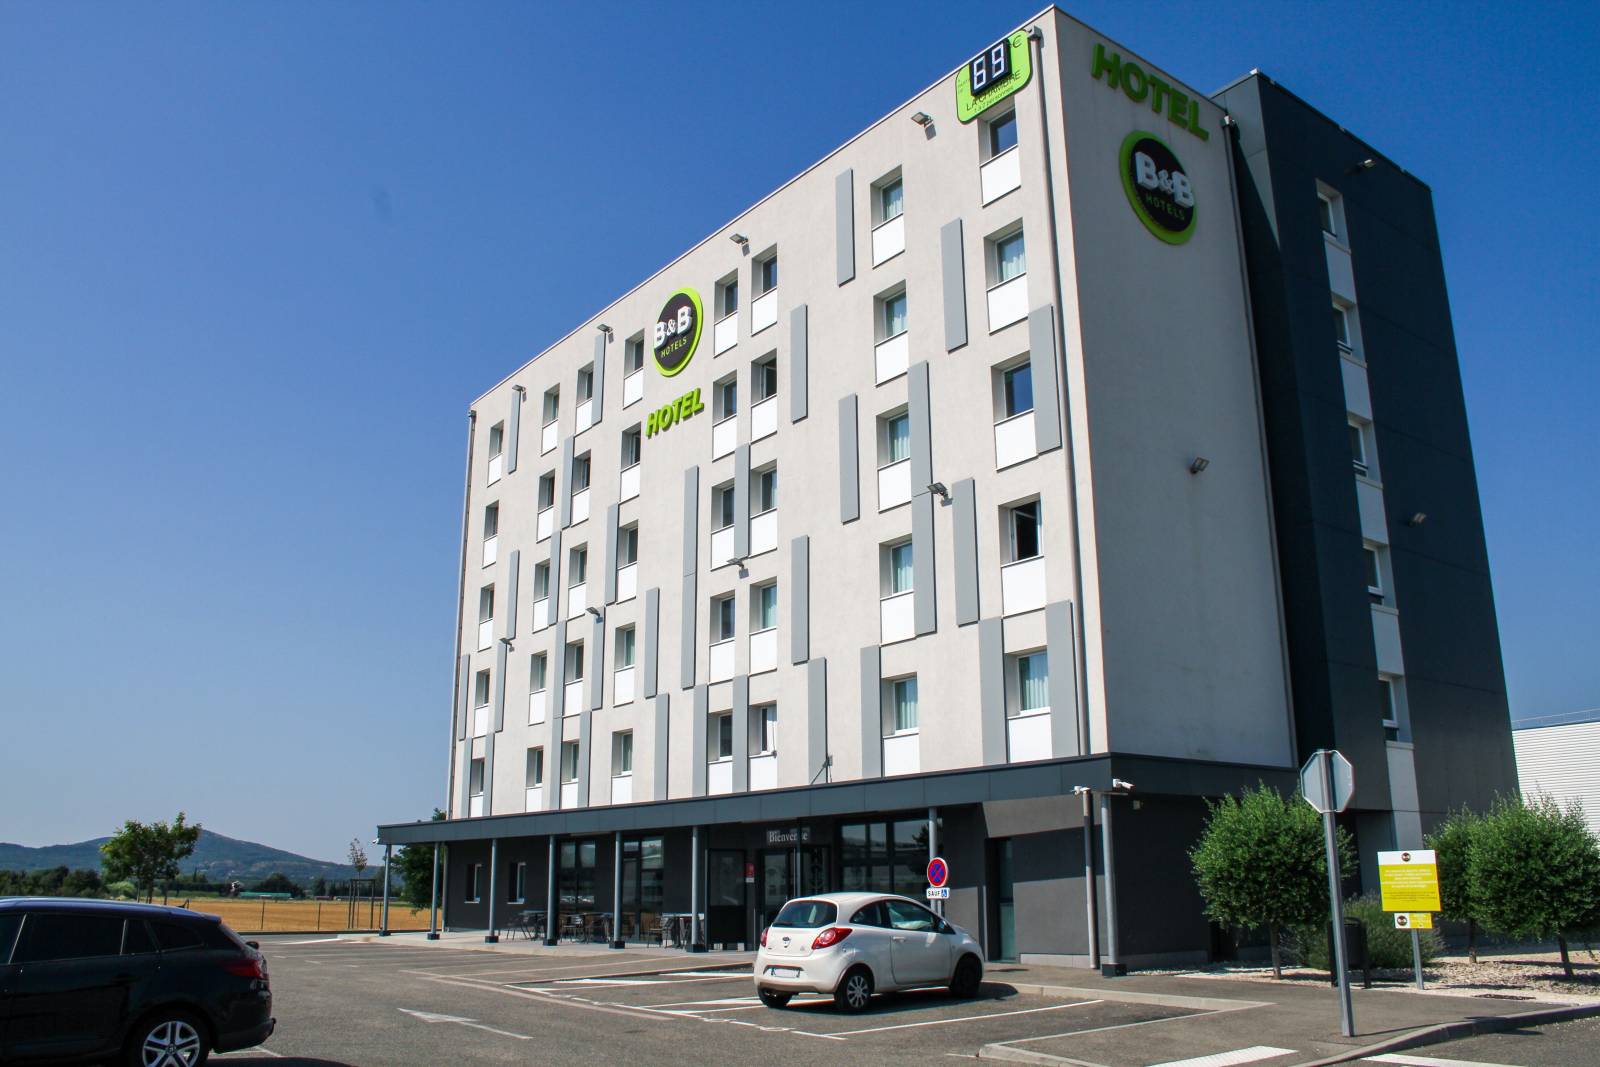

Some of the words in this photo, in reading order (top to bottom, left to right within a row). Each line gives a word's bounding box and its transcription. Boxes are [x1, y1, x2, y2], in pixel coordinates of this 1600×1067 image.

[1091, 43, 1209, 141] HOTEL
[1135, 151, 1195, 208] B&B
[1145, 193, 1185, 220] HOTELS
[654, 305, 692, 350] B&B
[660, 336, 688, 358] HOTELS
[645, 387, 704, 438] HOTEL
